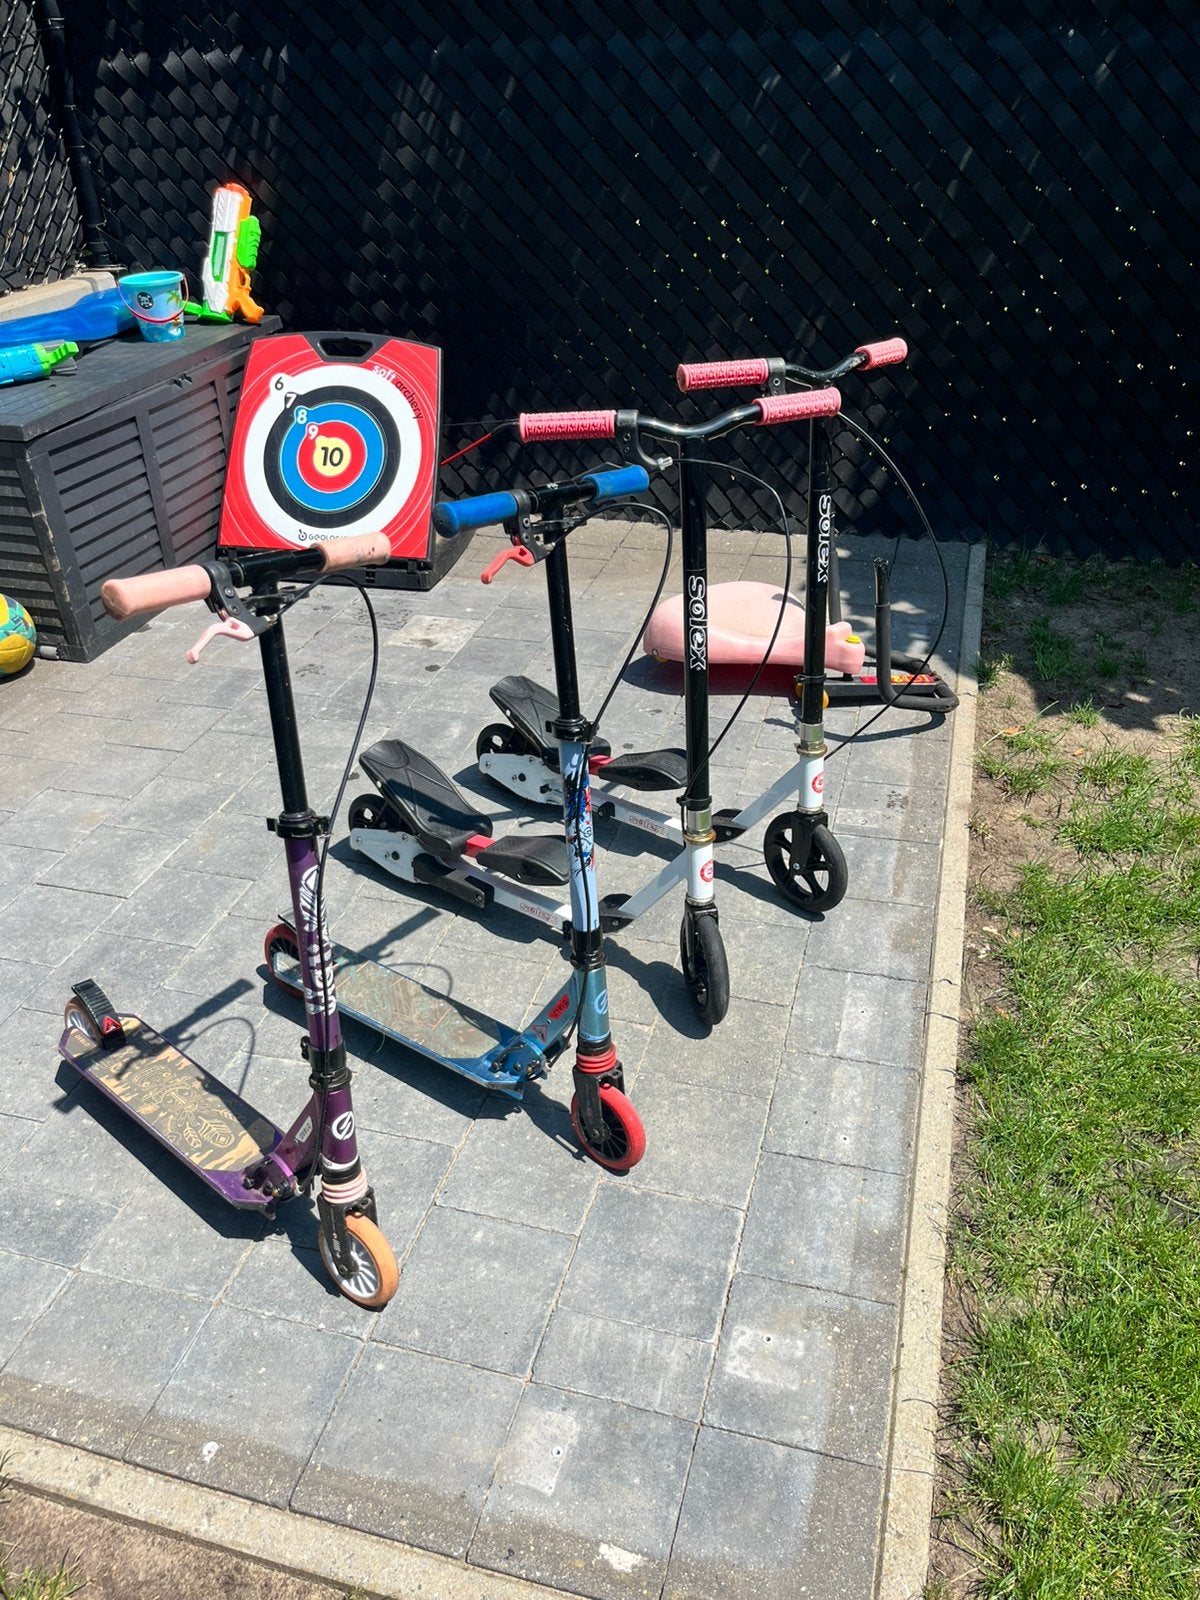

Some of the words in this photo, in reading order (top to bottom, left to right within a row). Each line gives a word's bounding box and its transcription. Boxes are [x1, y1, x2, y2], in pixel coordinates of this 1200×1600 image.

[274, 376, 284, 391] 6
[373, 365, 397, 381] soft
[395, 381, 423, 419] archery
[285, 393, 298, 409] 7
[296, 409, 308, 424] 8
[308, 424, 319, 440] 9
[320, 446, 344, 467] 10
